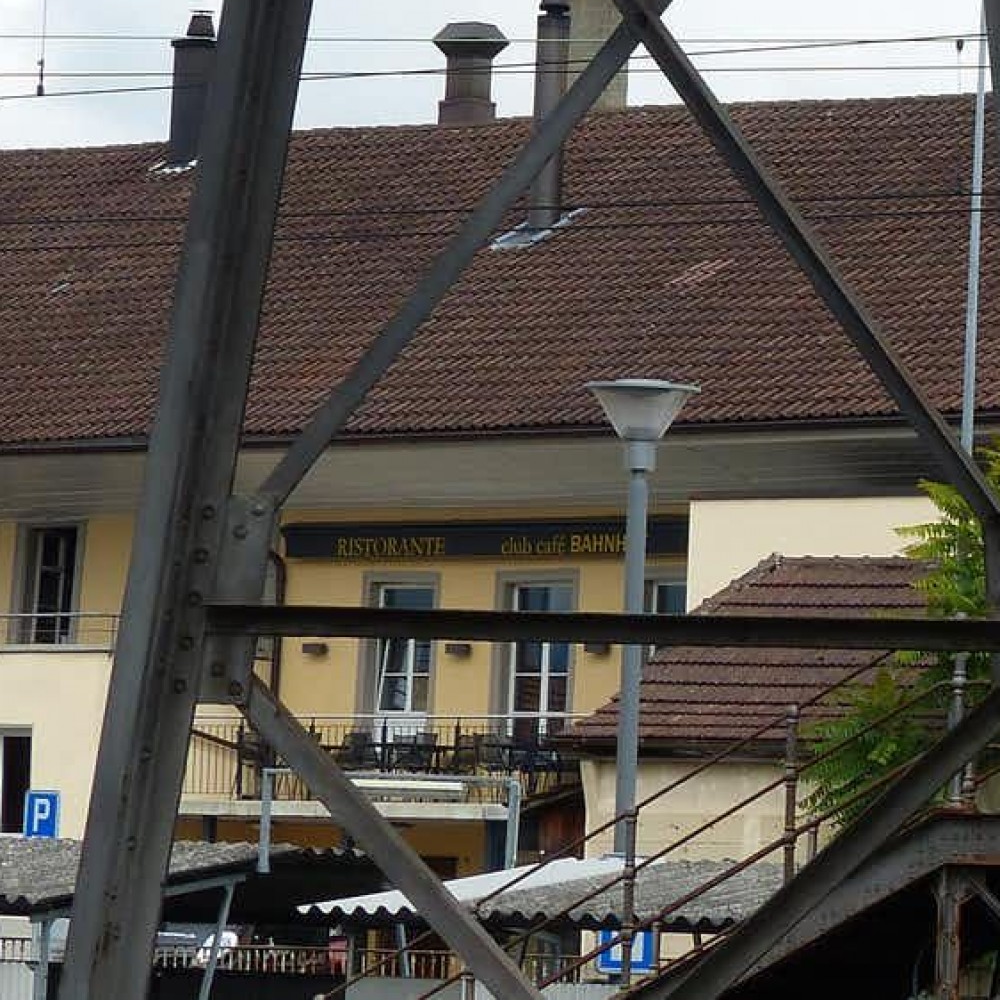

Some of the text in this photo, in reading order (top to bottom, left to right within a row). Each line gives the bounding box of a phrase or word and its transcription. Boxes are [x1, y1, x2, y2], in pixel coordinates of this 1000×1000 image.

[337, 536, 446, 556] RISTORANTE
[502, 536, 532, 554] club
[570, 533, 628, 553] BAHNH
[33, 798, 51, 832] P
